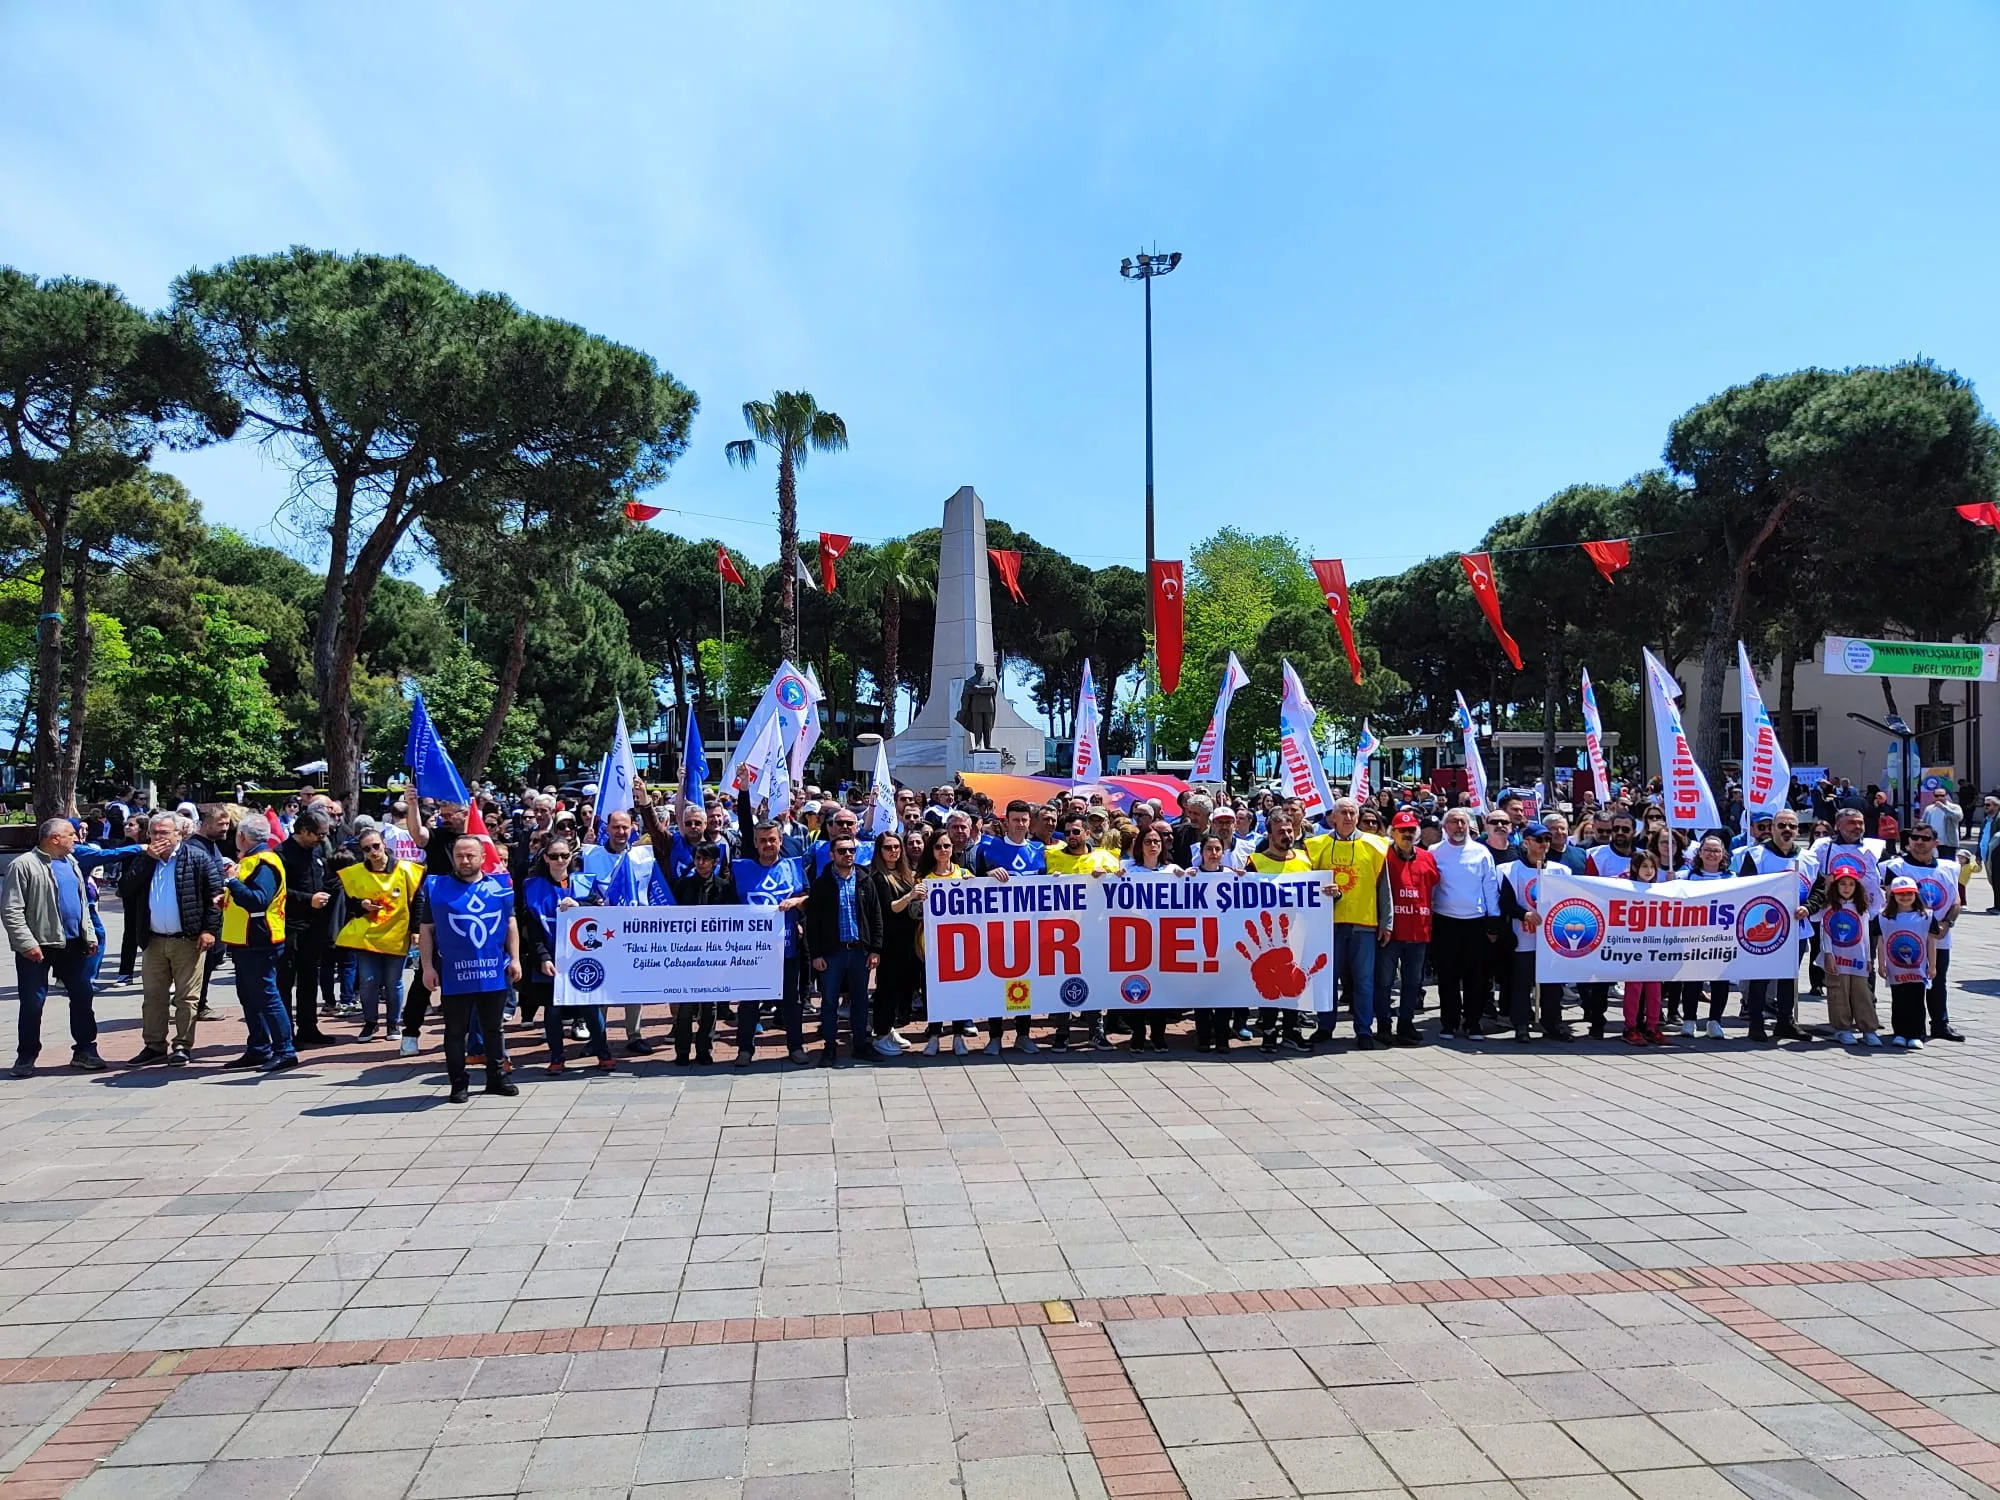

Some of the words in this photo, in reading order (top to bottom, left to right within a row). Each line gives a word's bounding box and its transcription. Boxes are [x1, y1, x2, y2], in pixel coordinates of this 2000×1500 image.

[1912, 664, 1938, 674] ENGEL
[930, 881, 1087, 916] ÖĞRETMENE
[1102, 877, 1208, 910] YÖNELİK
[1216, 877, 1321, 912] ŞİDDETE
[1400, 888, 1419, 898] DİSK
[1608, 900, 1735, 932] Eğitimiş
[623, 918, 696, 934] HÜRRİYETÇİ
[701, 917, 744, 932] EĞİTİM
[748, 920, 772, 932] SEN
[706, 942, 722, 952] Hür
[756, 940, 772, 951] Hür
[1606, 935, 1631, 945] Eğitim
[1632, 936, 1642, 944] ve
[1642, 936, 1660, 944] Bilim
[1662, 934, 1700, 945] İşgörenleri
[1701, 934, 1734, 942] Sendikası
[936, 918, 1082, 982] DUR
[1108, 916, 1219, 973] DE!
[1600, 946, 1642, 964] Ünye
[1648, 946, 1738, 962] Temsilciliği
[633, 957, 660, 970] Eğitim
[664, 956, 727, 970] Çalışanlarının
